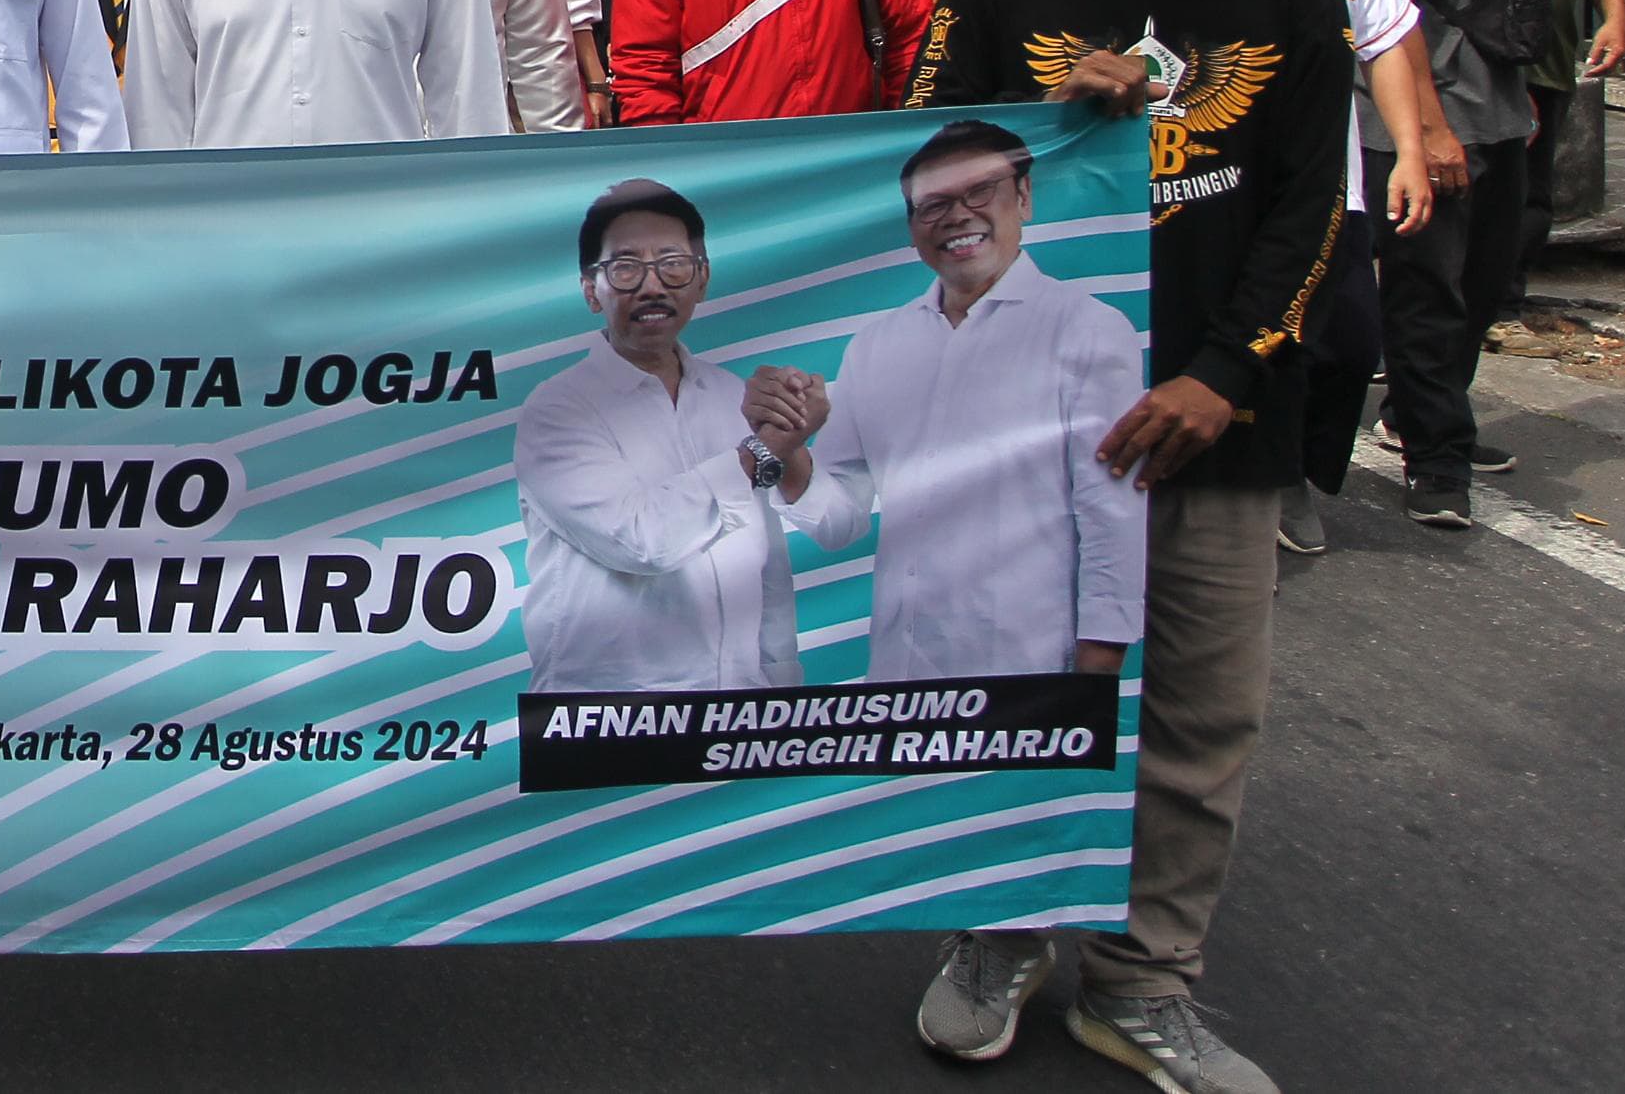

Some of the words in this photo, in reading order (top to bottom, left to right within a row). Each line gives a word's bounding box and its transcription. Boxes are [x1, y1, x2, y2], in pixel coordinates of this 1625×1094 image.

[1162, 165, 1241, 203] BERINGIN
[264, 350, 498, 407] JOGJA
[1, 553, 496, 634] RAHARJO
[542, 704, 693, 739] AFNAN
[701, 688, 988, 733] HADIKUSUMO
[125, 723, 184, 761] 28
[190, 723, 364, 771] Agustus
[373, 720, 488, 761] 2024
[702, 733, 881, 771] SINGGIH
[890, 727, 1095, 763] RAHARJO
